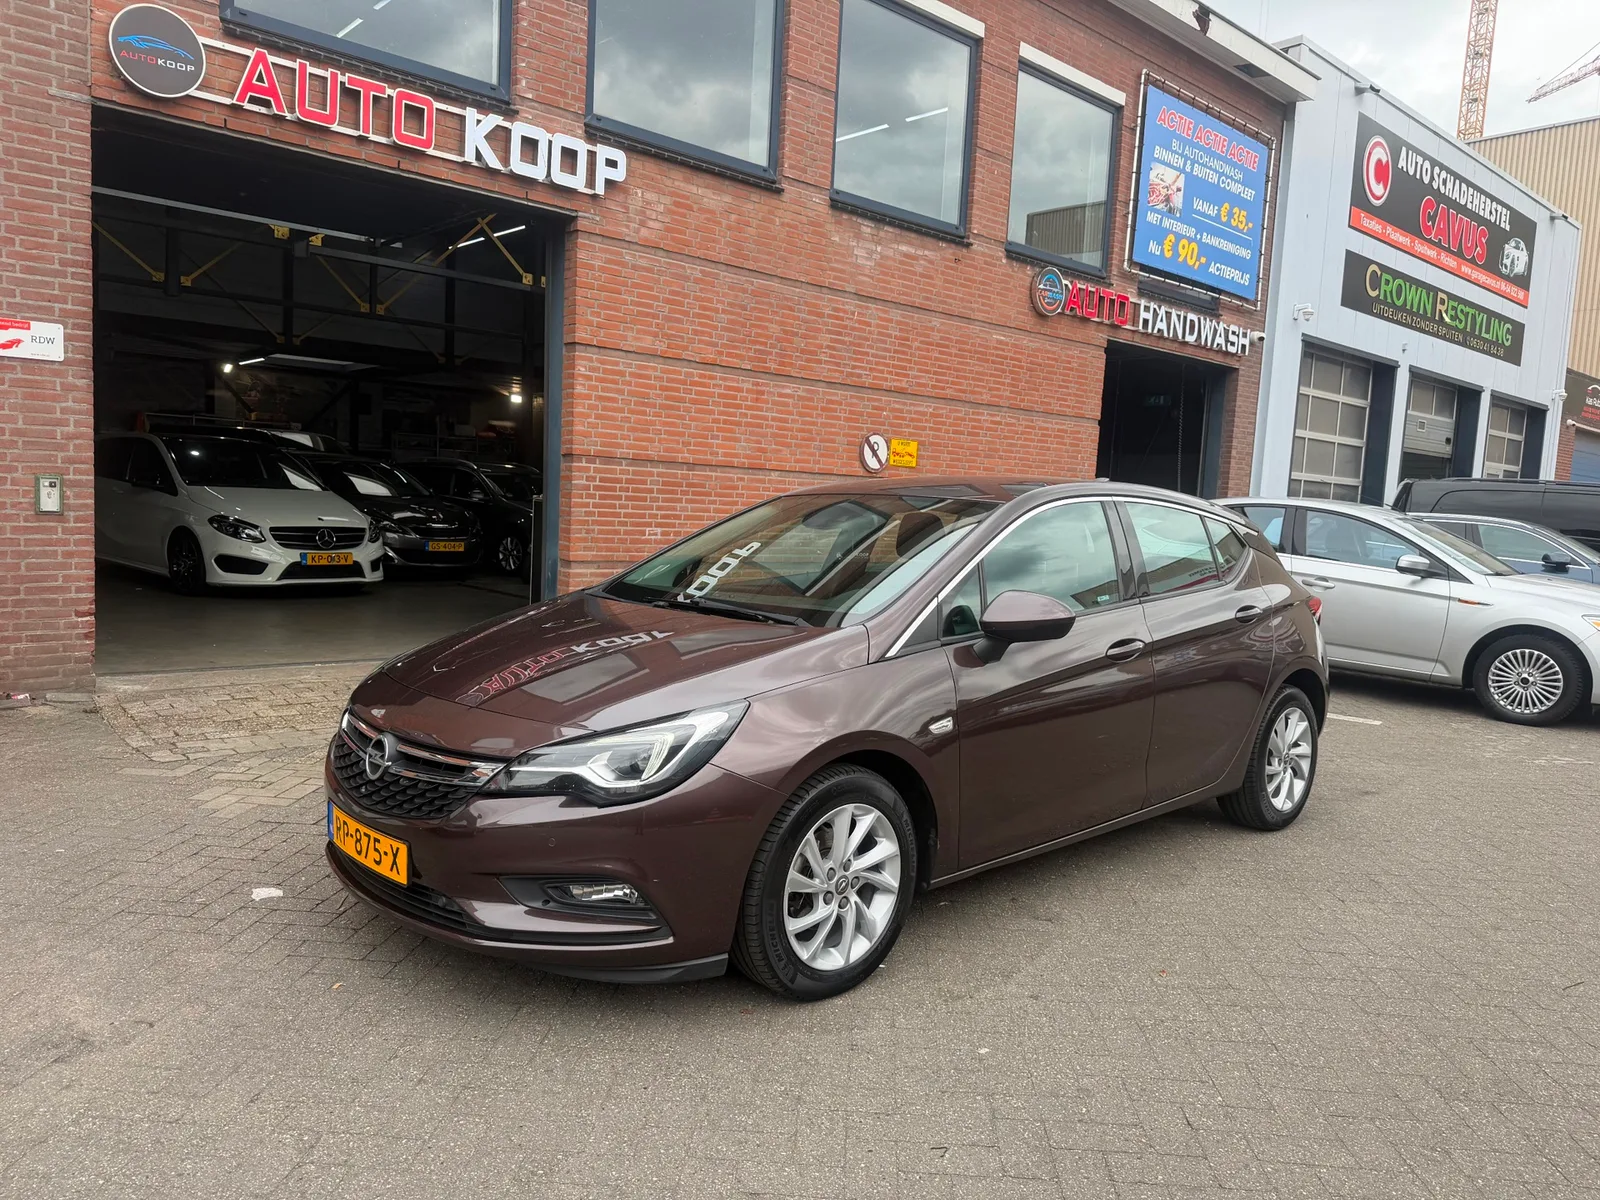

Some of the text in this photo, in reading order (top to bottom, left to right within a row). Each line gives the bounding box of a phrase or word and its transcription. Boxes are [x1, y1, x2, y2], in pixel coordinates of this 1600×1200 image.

[234, 47, 627, 196] AUTO KOOP
[1156, 106, 1260, 172] ACTIE ACTIE ACTIE
[1154, 145, 1185, 169] BINNEN
[1193, 163, 1219, 185] BUITEN
[1220, 176, 1256, 201] COMPLEET
[1184, 145, 1244, 182] AUTOHANDWASH
[1397, 146, 1511, 231] AUTO SCHADEHERSTEL
[1146, 211, 1162, 226] MET
[1162, 216, 1196, 239] INTERIEUR
[1202, 232, 1252, 260] BANKREINIGING
[1193, 197, 1219, 217] VANAF
[1420, 196, 1488, 264] CAVUS
[1208, 261, 1250, 286] ACTIEPRIJS
[1065, 280, 1251, 356] AUTO HANDWASH
[1366, 264, 1512, 346] CROWN RESTYLING
[1372, 302, 1412, 325] UITDEUKEN
[1412, 316, 1438, 334] ZONDER
[1438, 326, 1464, 343] SPUITEN
[31, 335, 55, 345] RDW
[335, 814, 400, 876] RP-875-X
